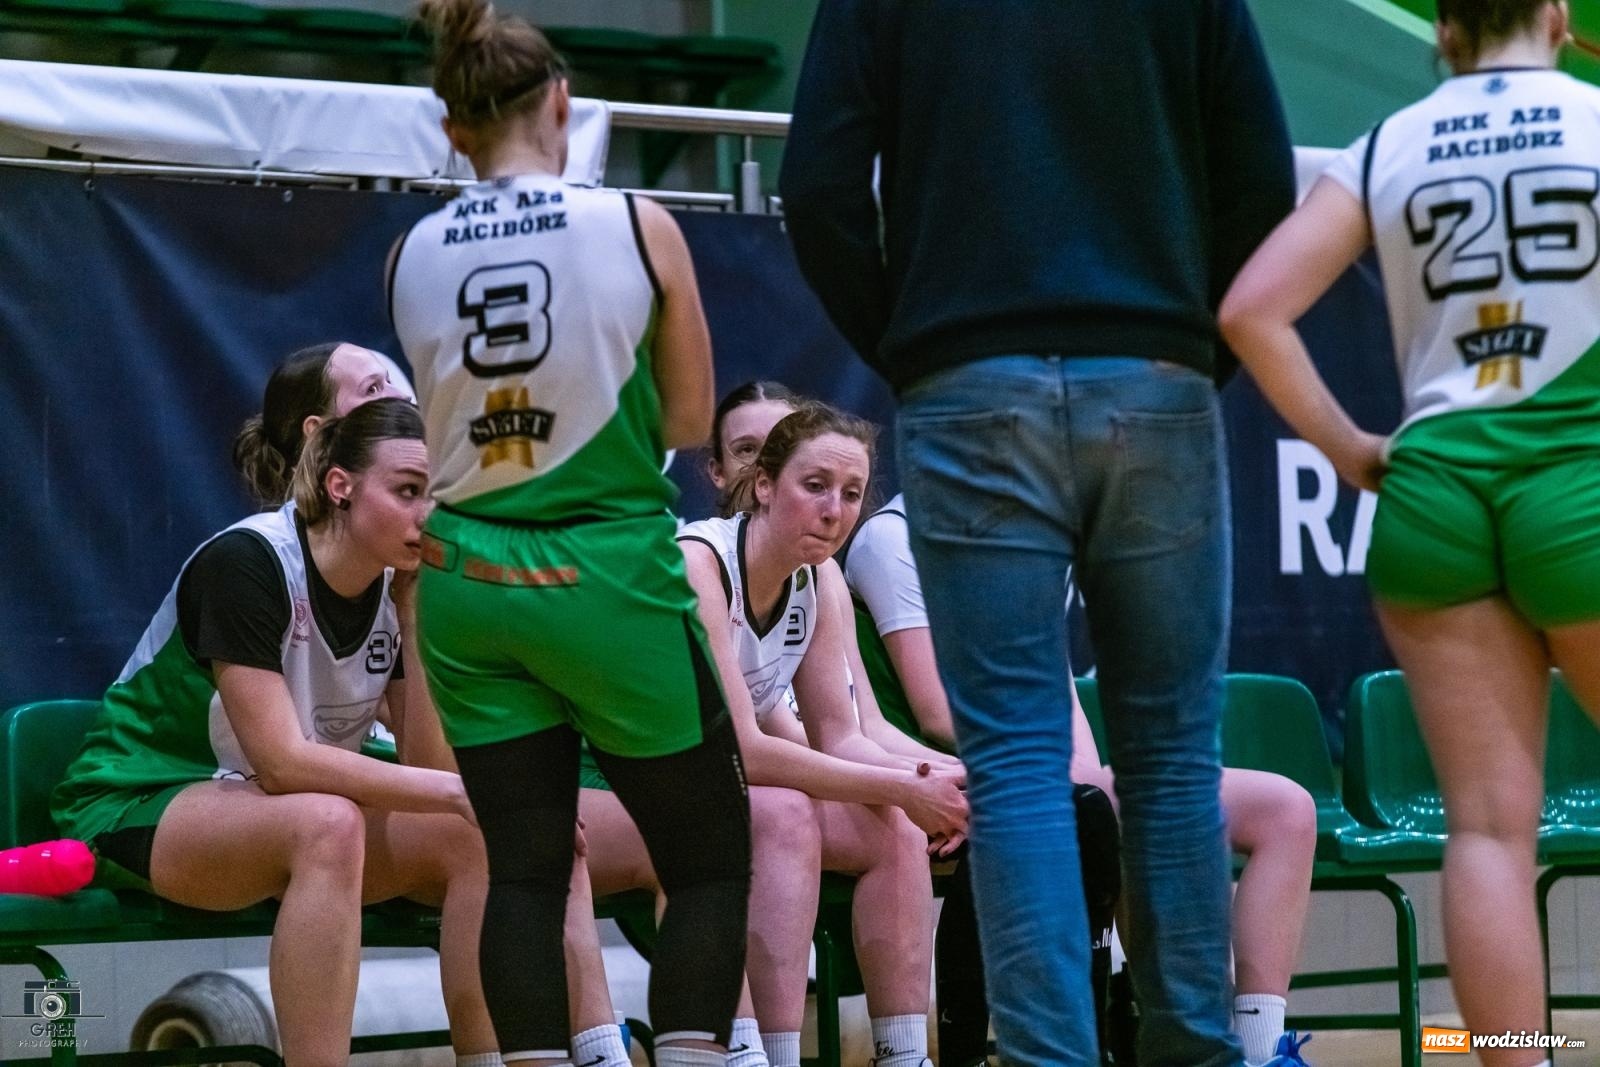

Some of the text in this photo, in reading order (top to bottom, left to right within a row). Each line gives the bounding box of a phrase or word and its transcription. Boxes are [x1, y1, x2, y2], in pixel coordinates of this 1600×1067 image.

[1510, 107, 1560, 125] AZS
[1427, 130, 1563, 163] RACIBÓRZ
[1405, 165, 1599, 302] 25
[457, 260, 552, 379] 3
[366, 630, 402, 674] 3
